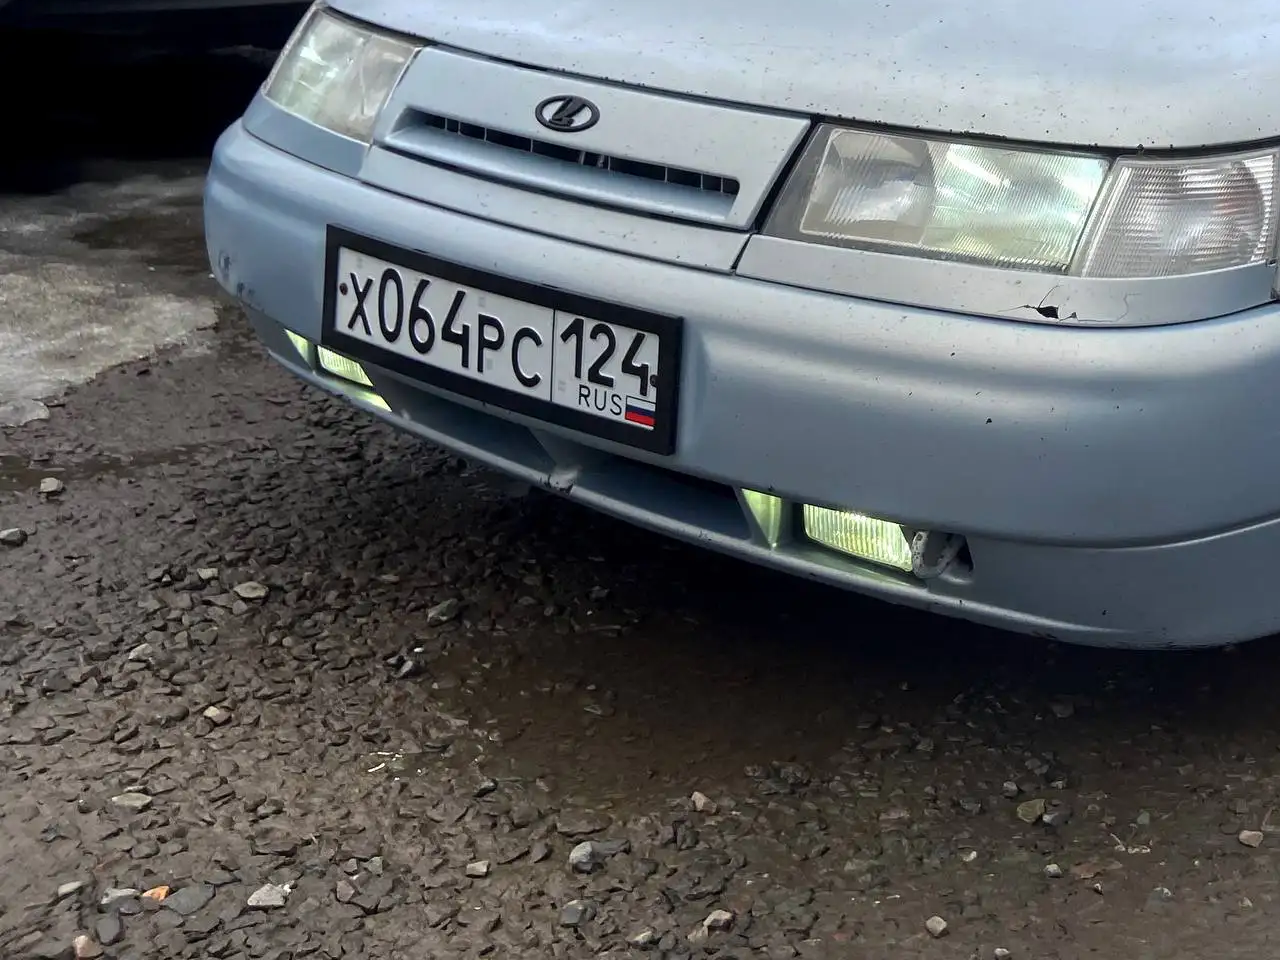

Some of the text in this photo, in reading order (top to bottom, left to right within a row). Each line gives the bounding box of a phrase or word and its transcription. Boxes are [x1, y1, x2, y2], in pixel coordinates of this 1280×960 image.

[347, 268, 649, 397] Х064РС 124
[578, 385, 623, 416] RUS
